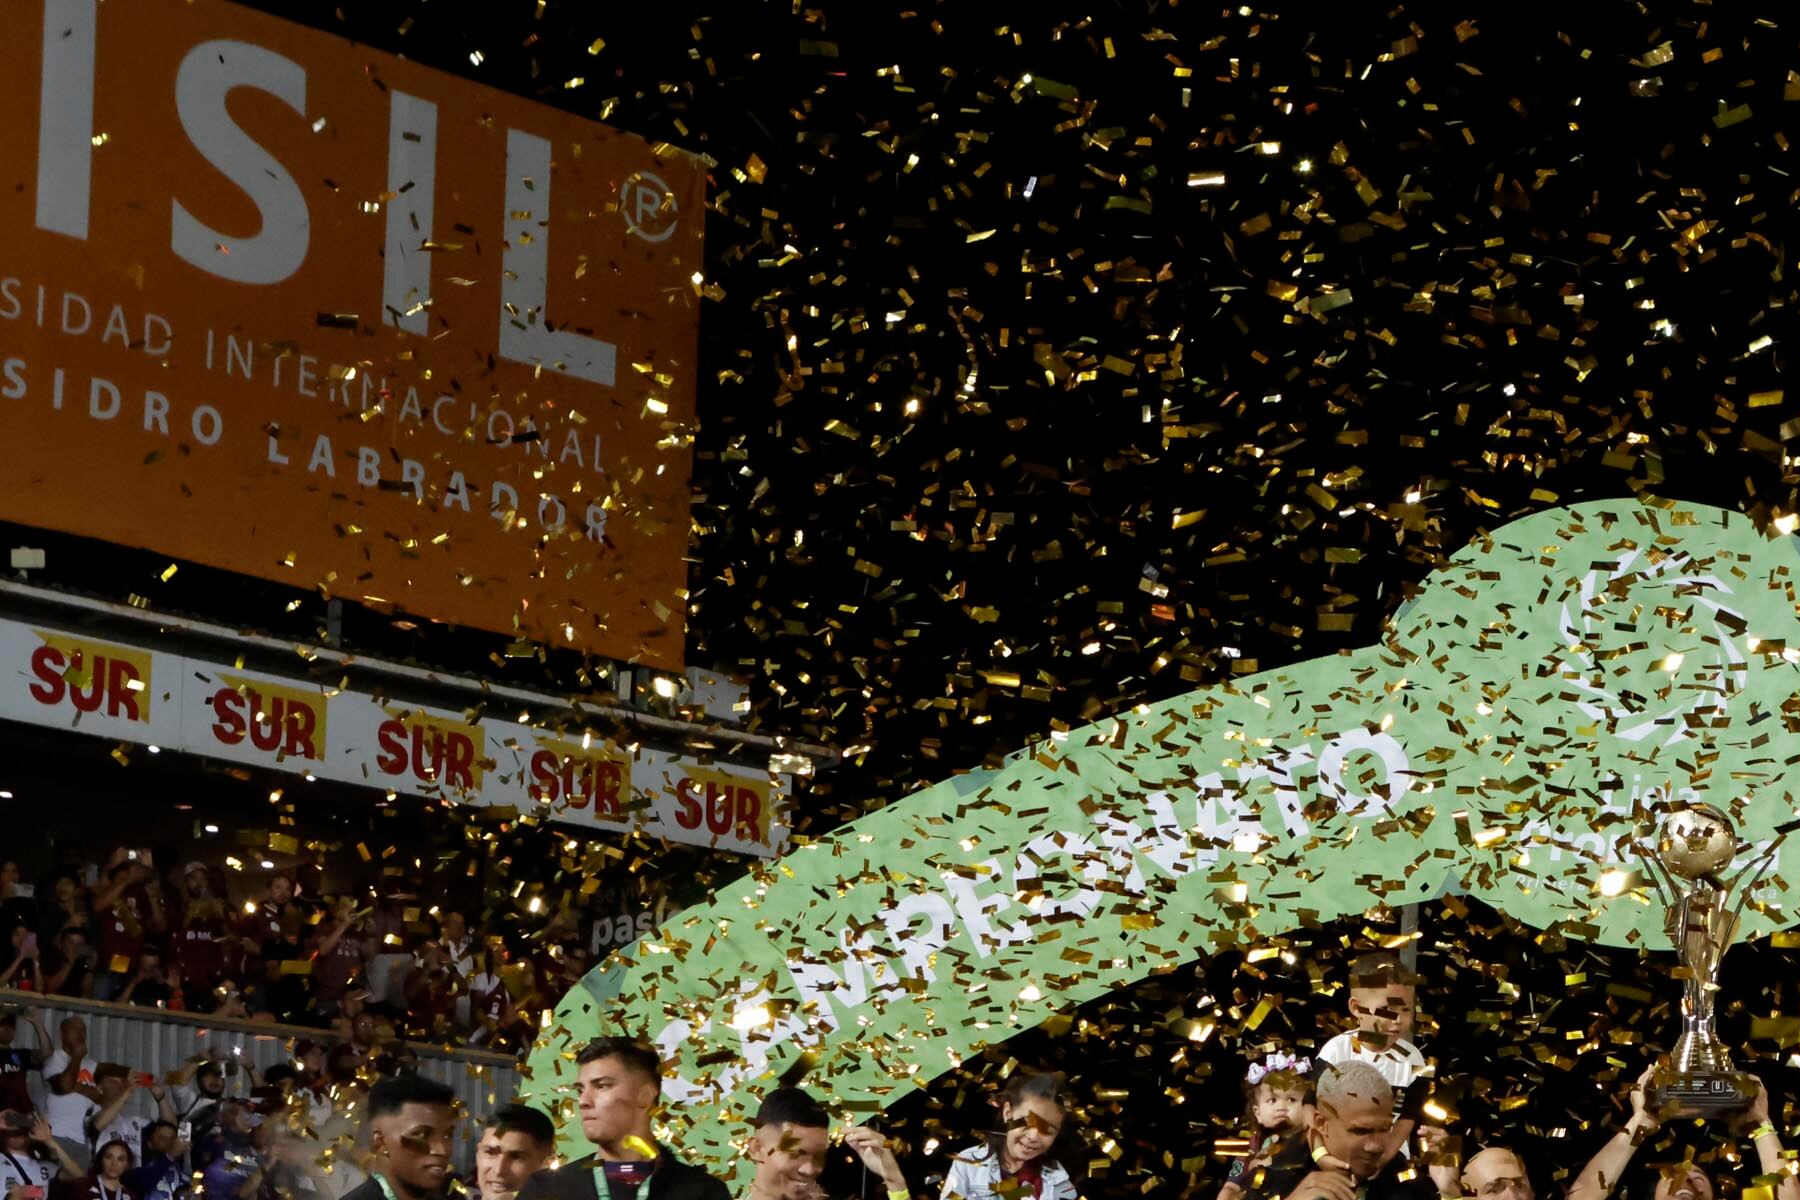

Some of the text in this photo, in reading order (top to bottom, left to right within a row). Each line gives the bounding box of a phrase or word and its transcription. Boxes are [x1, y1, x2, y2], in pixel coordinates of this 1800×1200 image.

[35, 0, 617, 387] ISIL
[2, 358, 223, 446] SIDRO
[268, 424, 609, 545] LABRADOR
[29, 646, 140, 721] SUR
[212, 688, 316, 759] SUR
[377, 720, 474, 789] SUR
[529, 749, 622, 813] SUR
[674, 777, 761, 842] SUR
